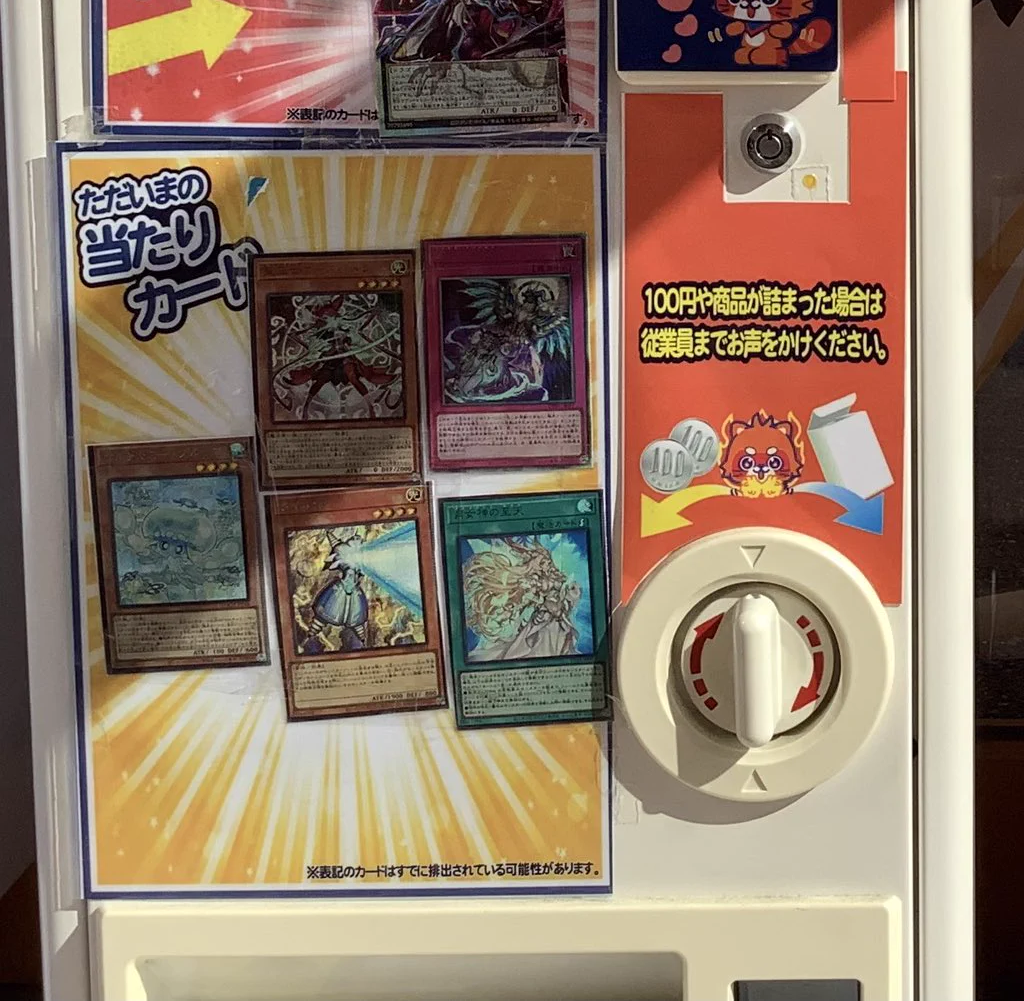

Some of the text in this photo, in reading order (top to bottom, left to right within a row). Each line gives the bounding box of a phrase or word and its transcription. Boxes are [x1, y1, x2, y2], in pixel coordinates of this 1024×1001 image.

[79, 174, 204, 216] ただいまの
[86, 211, 211, 277] 当たり
[134, 245, 249, 331] カード
[643, 284, 884, 317] 100円や商品が詰まった場合は
[640, 327, 888, 361] 従業員までお声をかけください。
